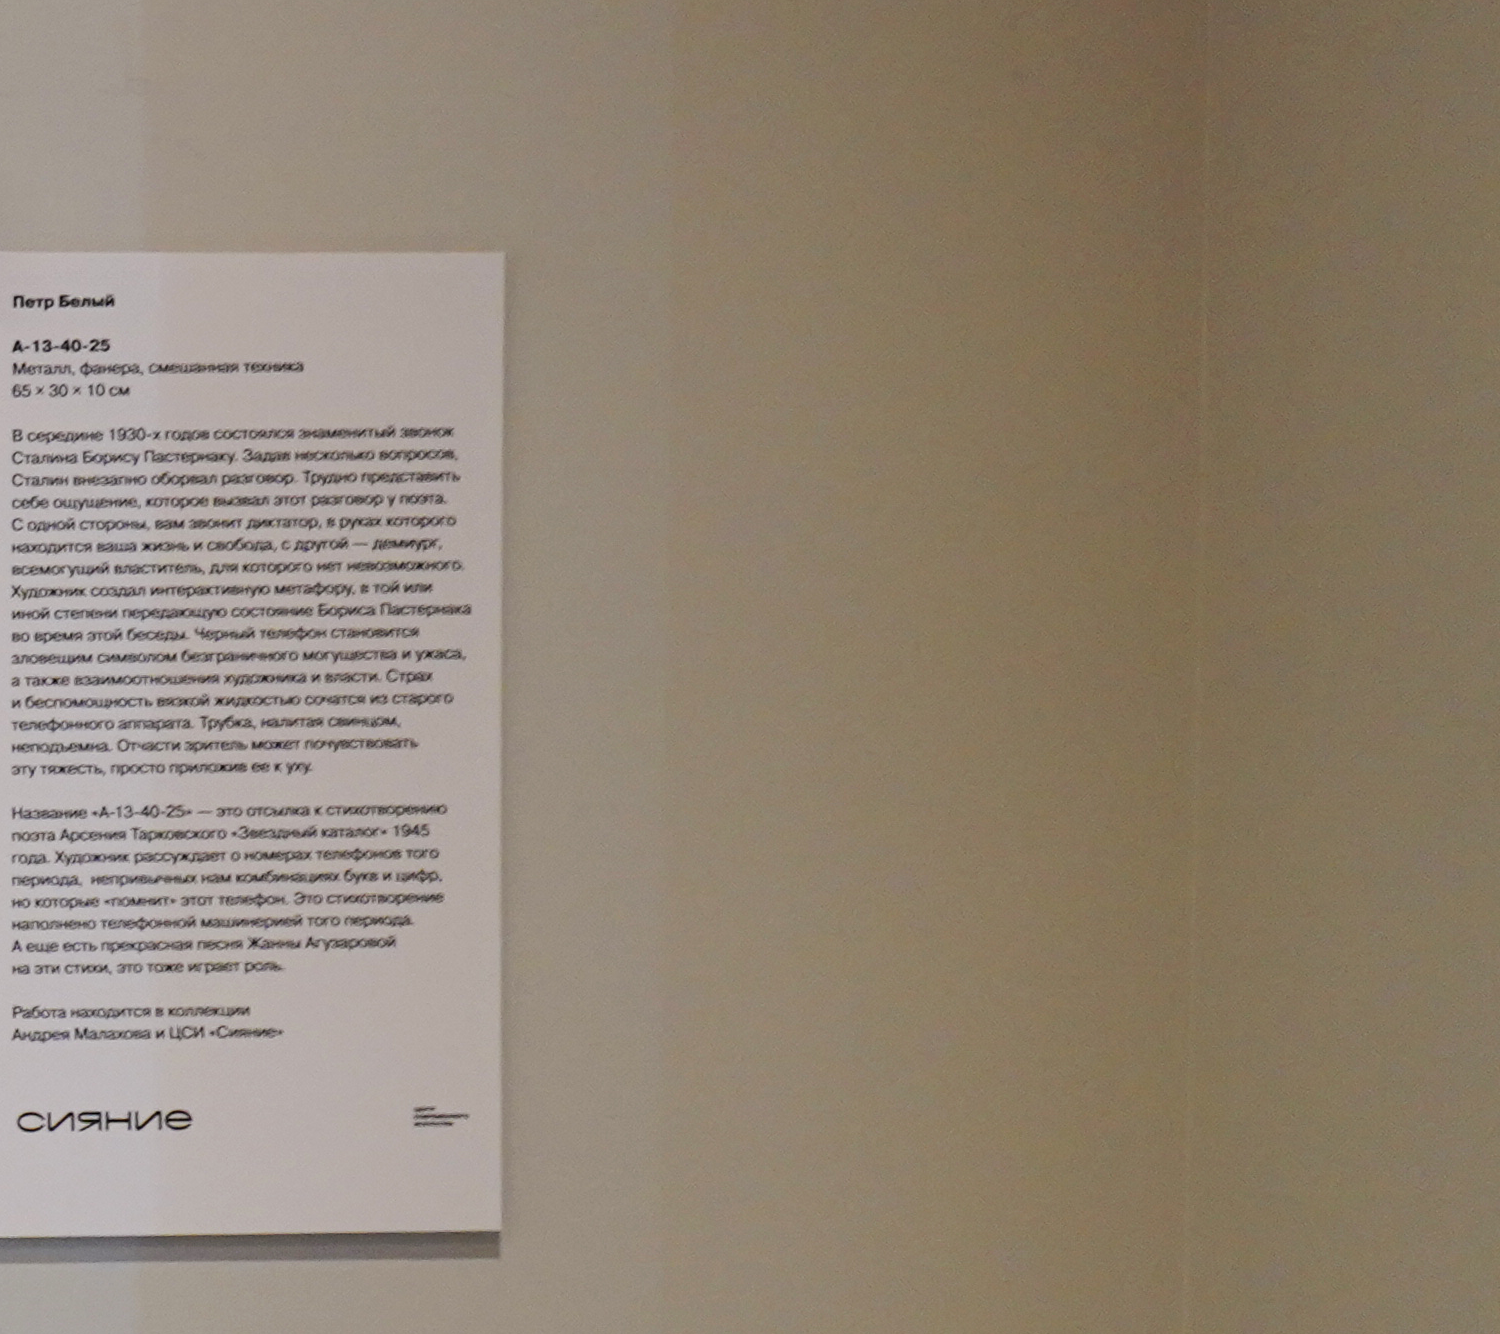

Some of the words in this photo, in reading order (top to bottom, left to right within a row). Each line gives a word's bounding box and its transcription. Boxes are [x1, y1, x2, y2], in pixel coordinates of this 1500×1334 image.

[13, 294, 55, 312] Петр
[58, 293, 116, 309] Белый
[12, 338, 111, 354] А-13-40-25
[244, 361, 305, 374] техника
[12, 383, 32, 399] 65
[49, 383, 69, 398] 30
[88, 382, 106, 397] 10
[108, 385, 131, 398] см
[12, 428, 23, 443] В
[26, 430, 104, 445] середине
[110, 426, 161, 442] 1930-х
[164, 429, 210, 443] годов
[12, 450, 78, 466] Сталина
[81, 449, 140, 467] Борису
[242, 448, 291, 464] Задав
[12, 472, 69, 488] Сталин
[150, 471, 218, 488] оборвал
[303, 469, 358, 487] Трудно
[12, 495, 50, 510] себе
[145, 496, 210, 511] которое
[273, 494, 306, 507] этот
[310, 494, 384, 509] разговор
[387, 494, 396, 508] у
[11, 517, 23, 532] С
[27, 517, 76, 533] одной
[326, 517, 336, 529] в
[338, 516, 382, 531] руках
[385, 515, 457, 530] которого
[96, 541, 138, 553] ваша
[141, 540, 190, 553] жизнь
[192, 541, 204, 552] и
[281, 539, 291, 551] с
[294, 536, 349, 553] другой
[209, 562, 239, 576] для
[241, 561, 313, 576] которого
[11, 584, 86, 601] Художник
[90, 585, 147, 599] создал
[359, 583, 370, 595] в
[374, 580, 400, 595] той
[403, 582, 434, 594] или
[11, 606, 51, 621] иной
[53, 608, 119, 621] степени
[317, 602, 377, 620] Бориса
[11, 631, 30, 643] во
[33, 630, 84, 645] время
[87, 627, 123, 643] этой
[194, 626, 256, 643] Черный
[260, 626, 327, 642] телефон
[12, 653, 94, 666] зловещим
[401, 649, 412, 660] и
[11, 676, 21, 688] а
[25, 675, 70, 687] также
[310, 673, 321, 684] и
[385, 668, 433, 685] Страх
[11, 699, 22, 709] и
[369, 693, 389, 706] из
[391, 692, 455, 707] старого
[116, 738, 181, 753] Отчасти
[184, 740, 248, 754] зритель
[250, 739, 300, 751] может
[12, 764, 37, 779] эту
[110, 763, 166, 777] просто
[273, 762, 282, 773] к
[12, 806, 88, 820] Название
[216, 806, 243, 818] это
[313, 805, 323, 816] к
[12, 830, 56, 843] поэта
[59, 828, 127, 844] Арсения
[394, 823, 431, 838] 1945
[55, 850, 130, 867] Художник
[230, 850, 241, 863] о
[243, 849, 312, 864] номерах
[406, 848, 441, 860] того
[200, 873, 232, 885] нам
[343, 868, 379, 885] букв
[382, 871, 393, 882] и
[12, 897, 31, 909] но
[34, 896, 100, 911] которые
[180, 895, 213, 907] этот
[293, 891, 324, 906] Это
[308, 915, 341, 928] того
[12, 939, 22, 953] А
[25, 941, 59, 954] еще
[62, 941, 97, 953] есть
[12, 964, 31, 975] на
[34, 964, 61, 975] эти
[117, 962, 143, 974] это
[147, 962, 184, 974] тоже
[187, 961, 240, 975] играет
[12, 1004, 67, 1020] Работа
[154, 1006, 165, 1018] в
[12, 1027, 71, 1044] Андрея
[73, 1027, 152, 1041] Малахова
[155, 1029, 166, 1040] и
[168, 1025, 206, 1042] ЦСИ
